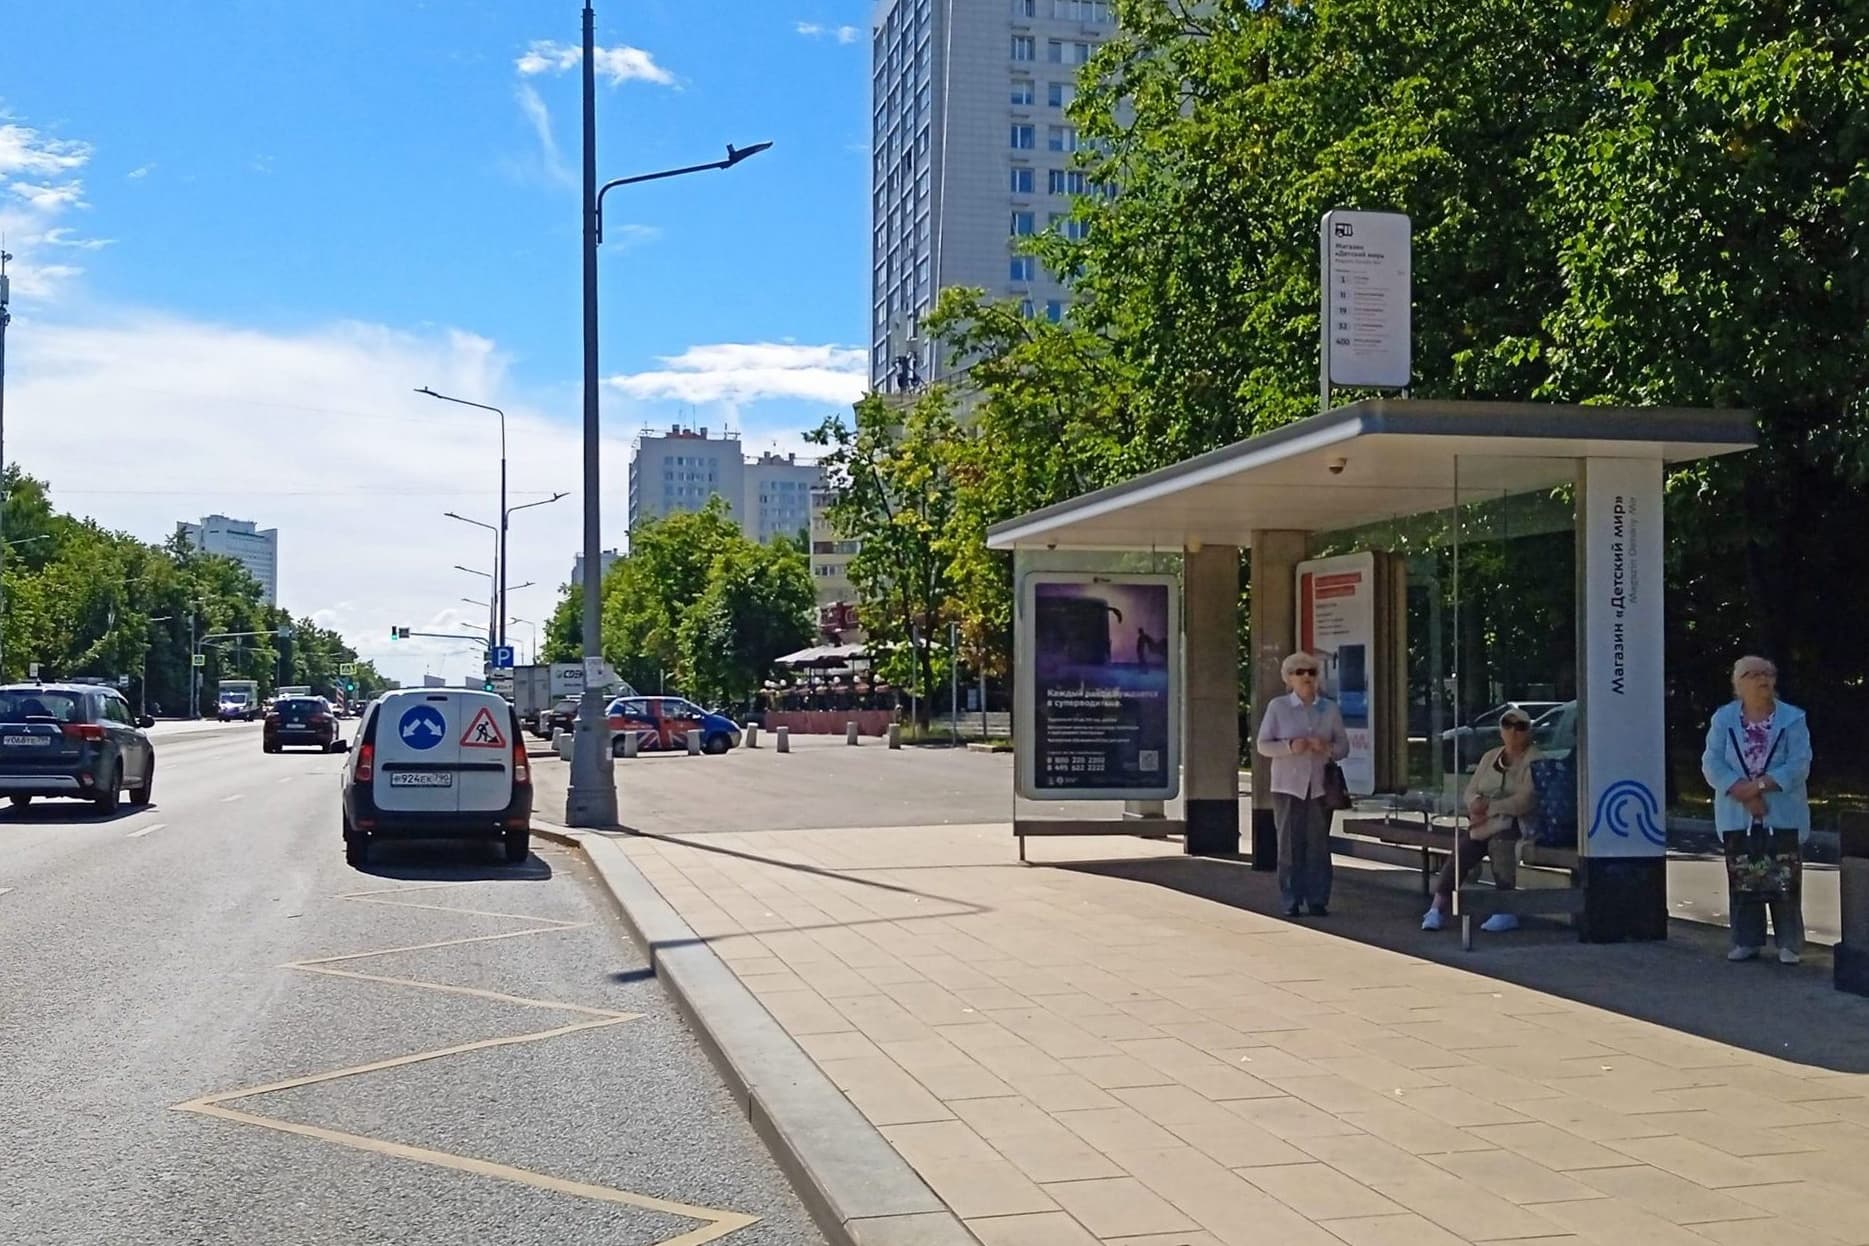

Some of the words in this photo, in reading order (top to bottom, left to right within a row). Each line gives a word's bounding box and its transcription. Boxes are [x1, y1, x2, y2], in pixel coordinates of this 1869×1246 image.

[1336, 336, 1351, 346] 400
[1612, 496, 1626, 538] мир»
[1610, 543, 1626, 619] «Детский
[497, 649, 511, 665] P
[1611, 623, 1625, 695] Магазин
